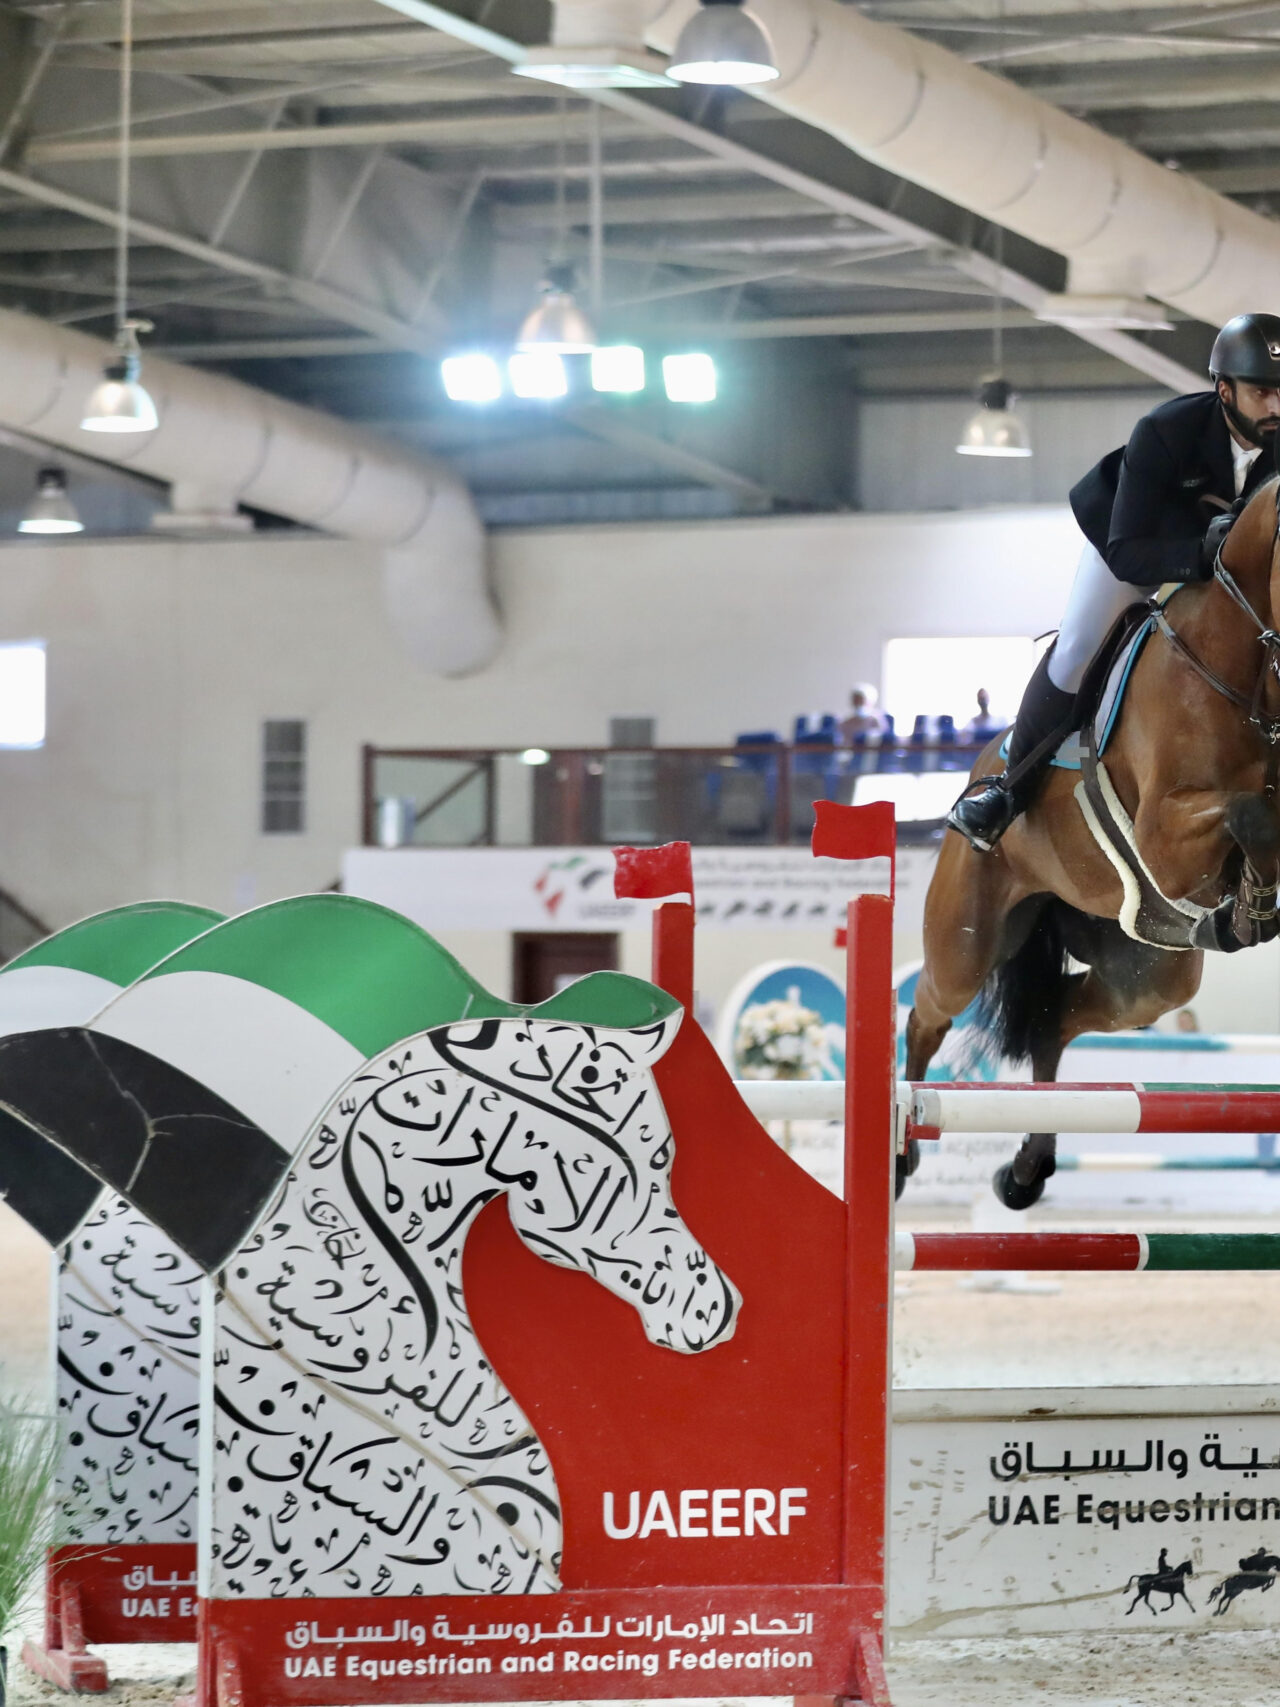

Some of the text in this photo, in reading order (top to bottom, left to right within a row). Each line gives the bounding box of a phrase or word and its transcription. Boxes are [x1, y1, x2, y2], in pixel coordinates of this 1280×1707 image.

[989, 1439, 1188, 1482] والسباق
[603, 1488, 808, 1540] UAEERF
[988, 1495, 1060, 1526] UAE
[122, 1598, 170, 1617] UAE
[285, 1613, 813, 1649] اتحاد الإمارات للفروسية والسباق
[284, 1647, 813, 1681] UAE Equestrian and Racing Federation
